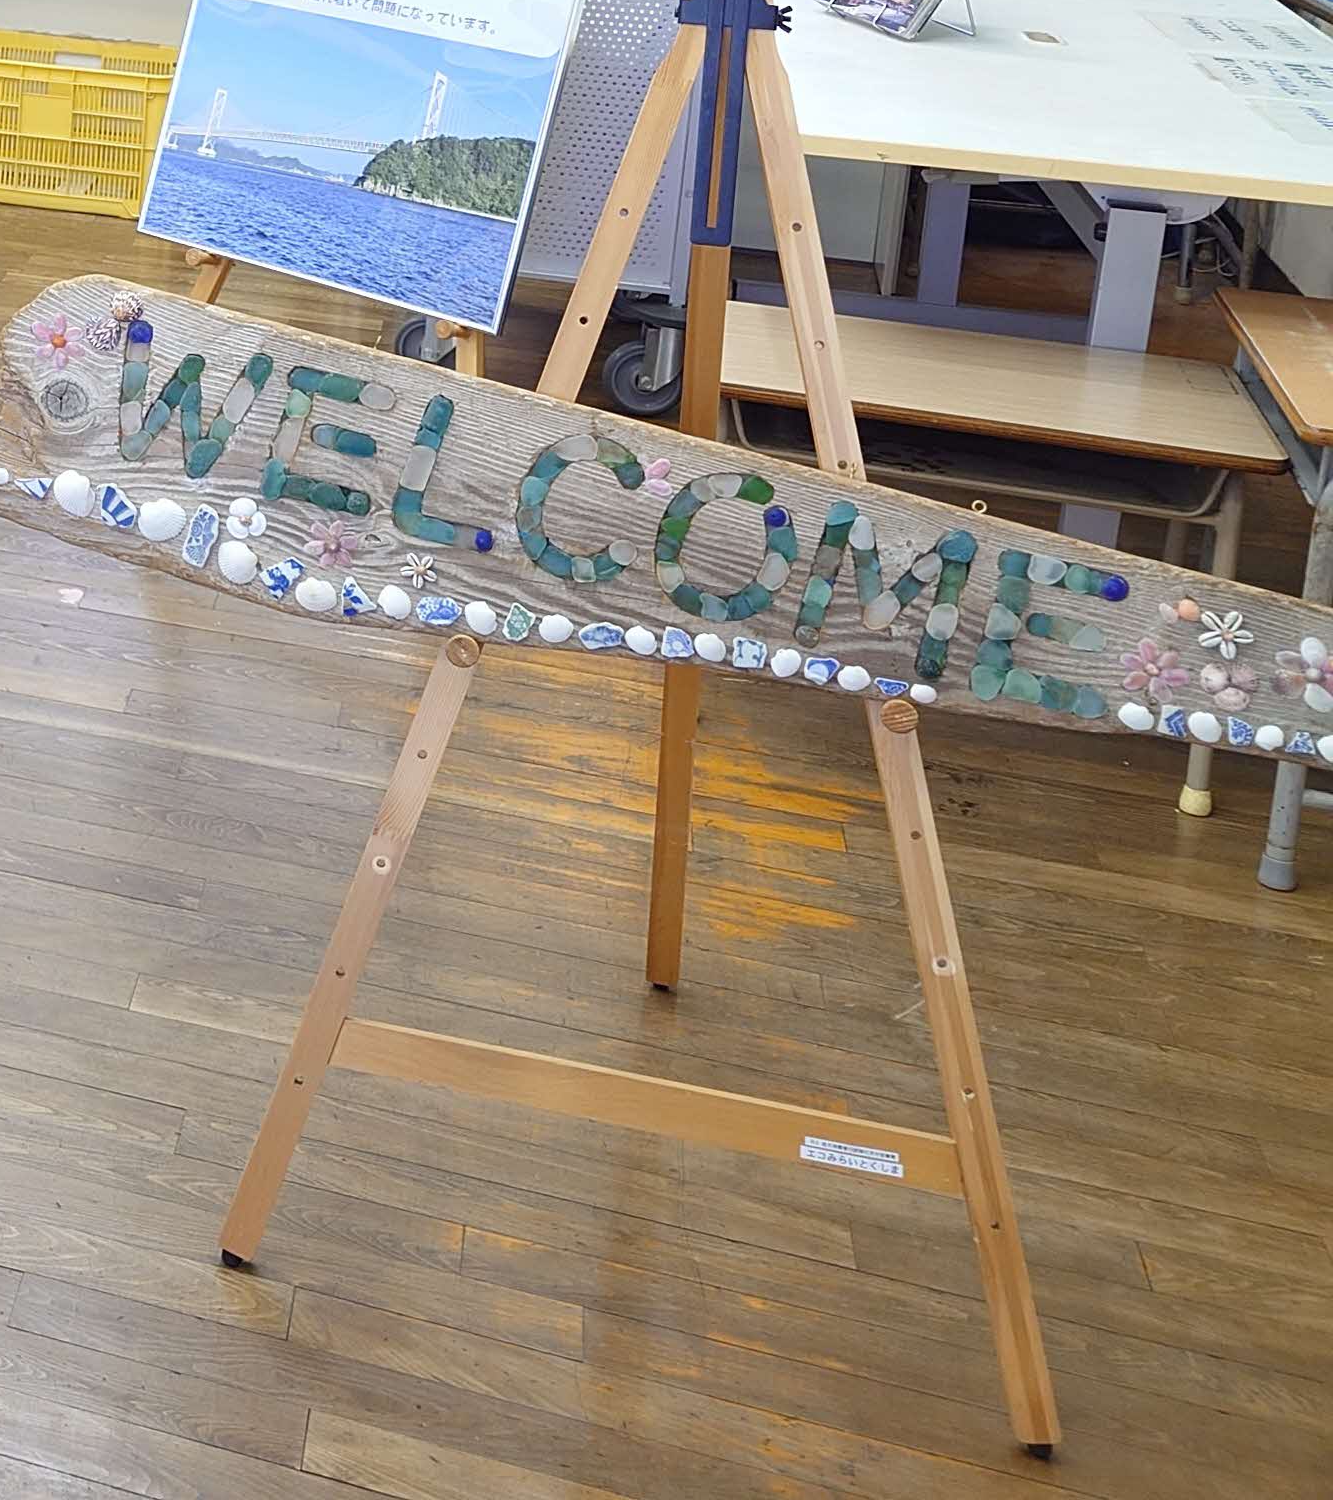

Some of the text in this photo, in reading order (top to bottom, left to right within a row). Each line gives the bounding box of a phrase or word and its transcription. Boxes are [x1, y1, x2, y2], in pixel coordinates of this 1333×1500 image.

[119, 319, 1130, 718] WELCOME
[806, 1149, 899, 1175] エコみらいとくしま
